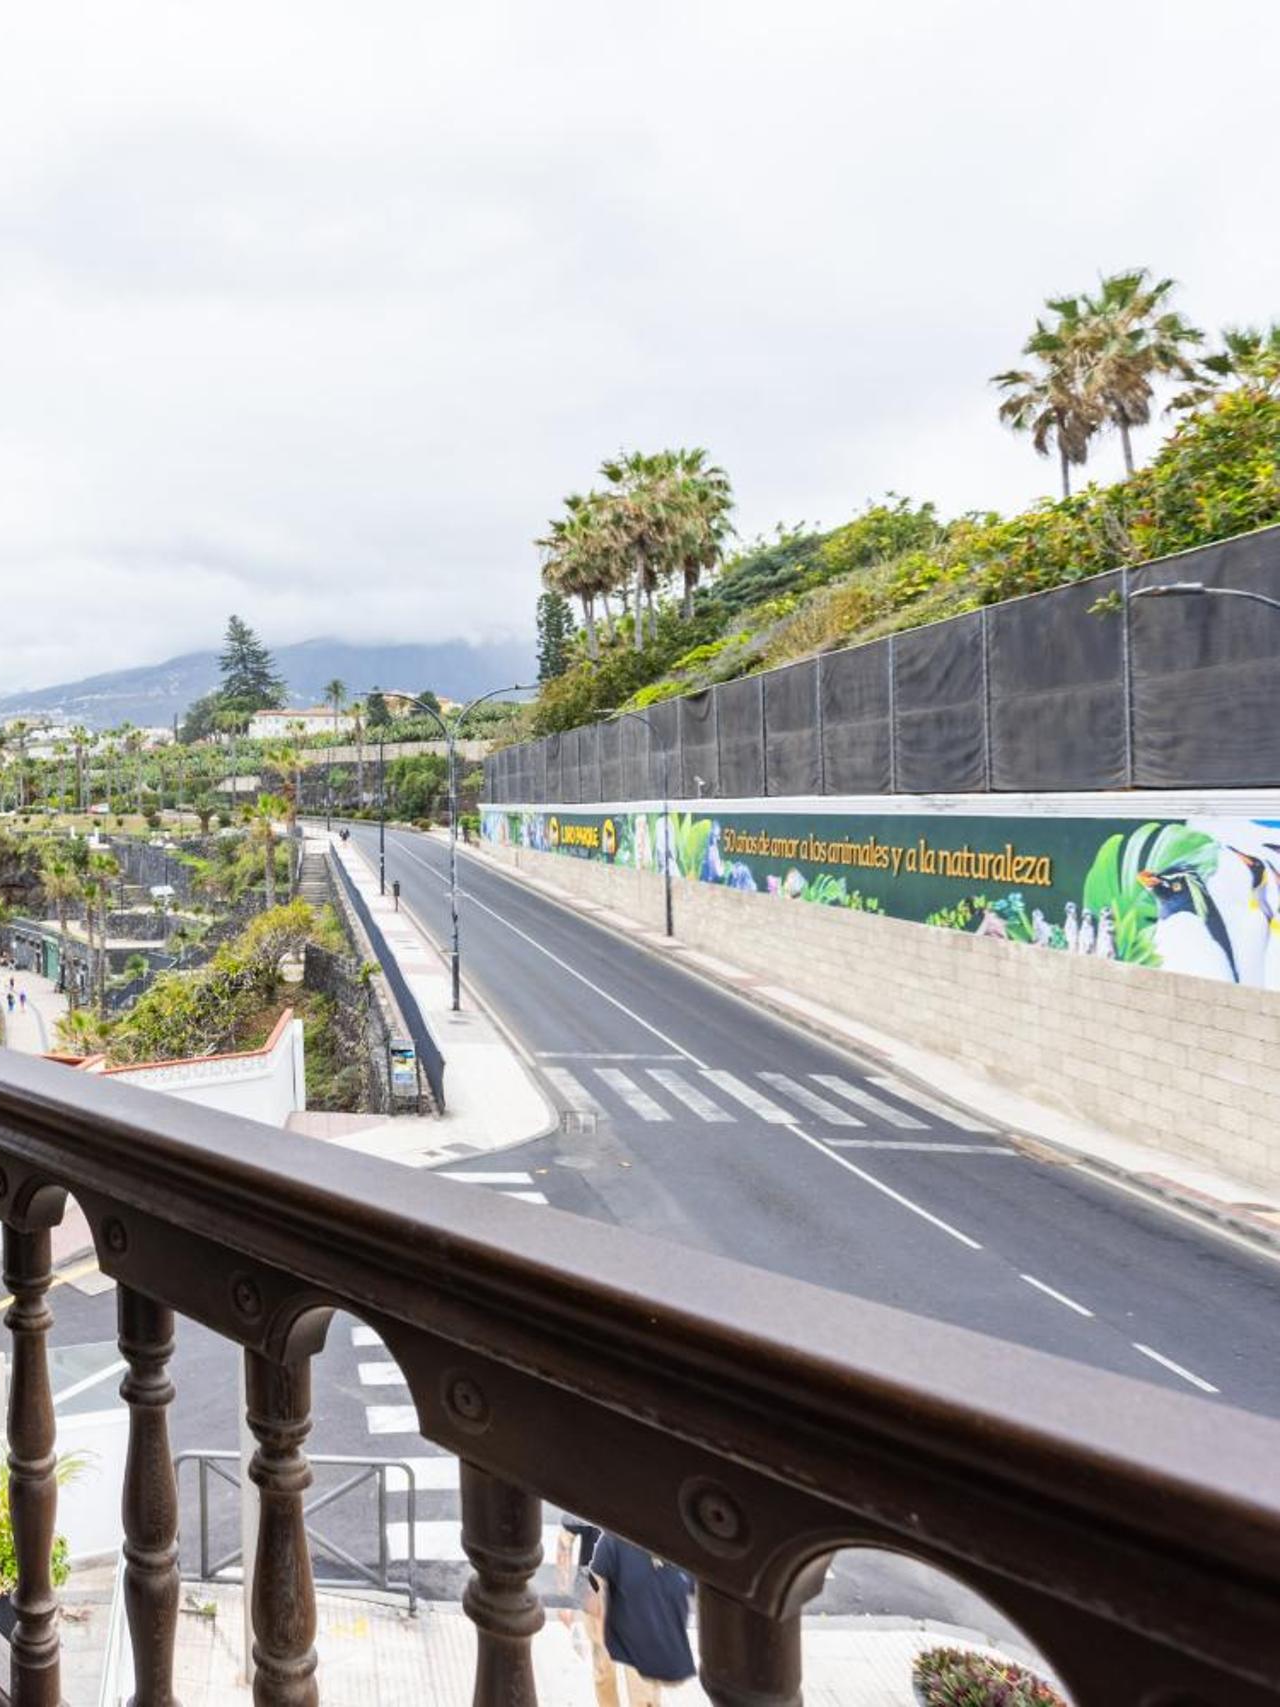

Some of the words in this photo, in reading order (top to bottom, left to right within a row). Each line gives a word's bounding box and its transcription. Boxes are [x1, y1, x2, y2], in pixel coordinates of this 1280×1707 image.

[723, 828, 736, 853] 50
[759, 829, 770, 857] de
[770, 838, 800, 859] amor
[800, 840, 808, 860] a
[808, 833, 826, 863] los
[827, 835, 890, 869] animales
[891, 847, 904, 877] y
[905, 848, 917, 873] a
[919, 838, 936, 875] la
[938, 843, 1053, 887] naturaleza
